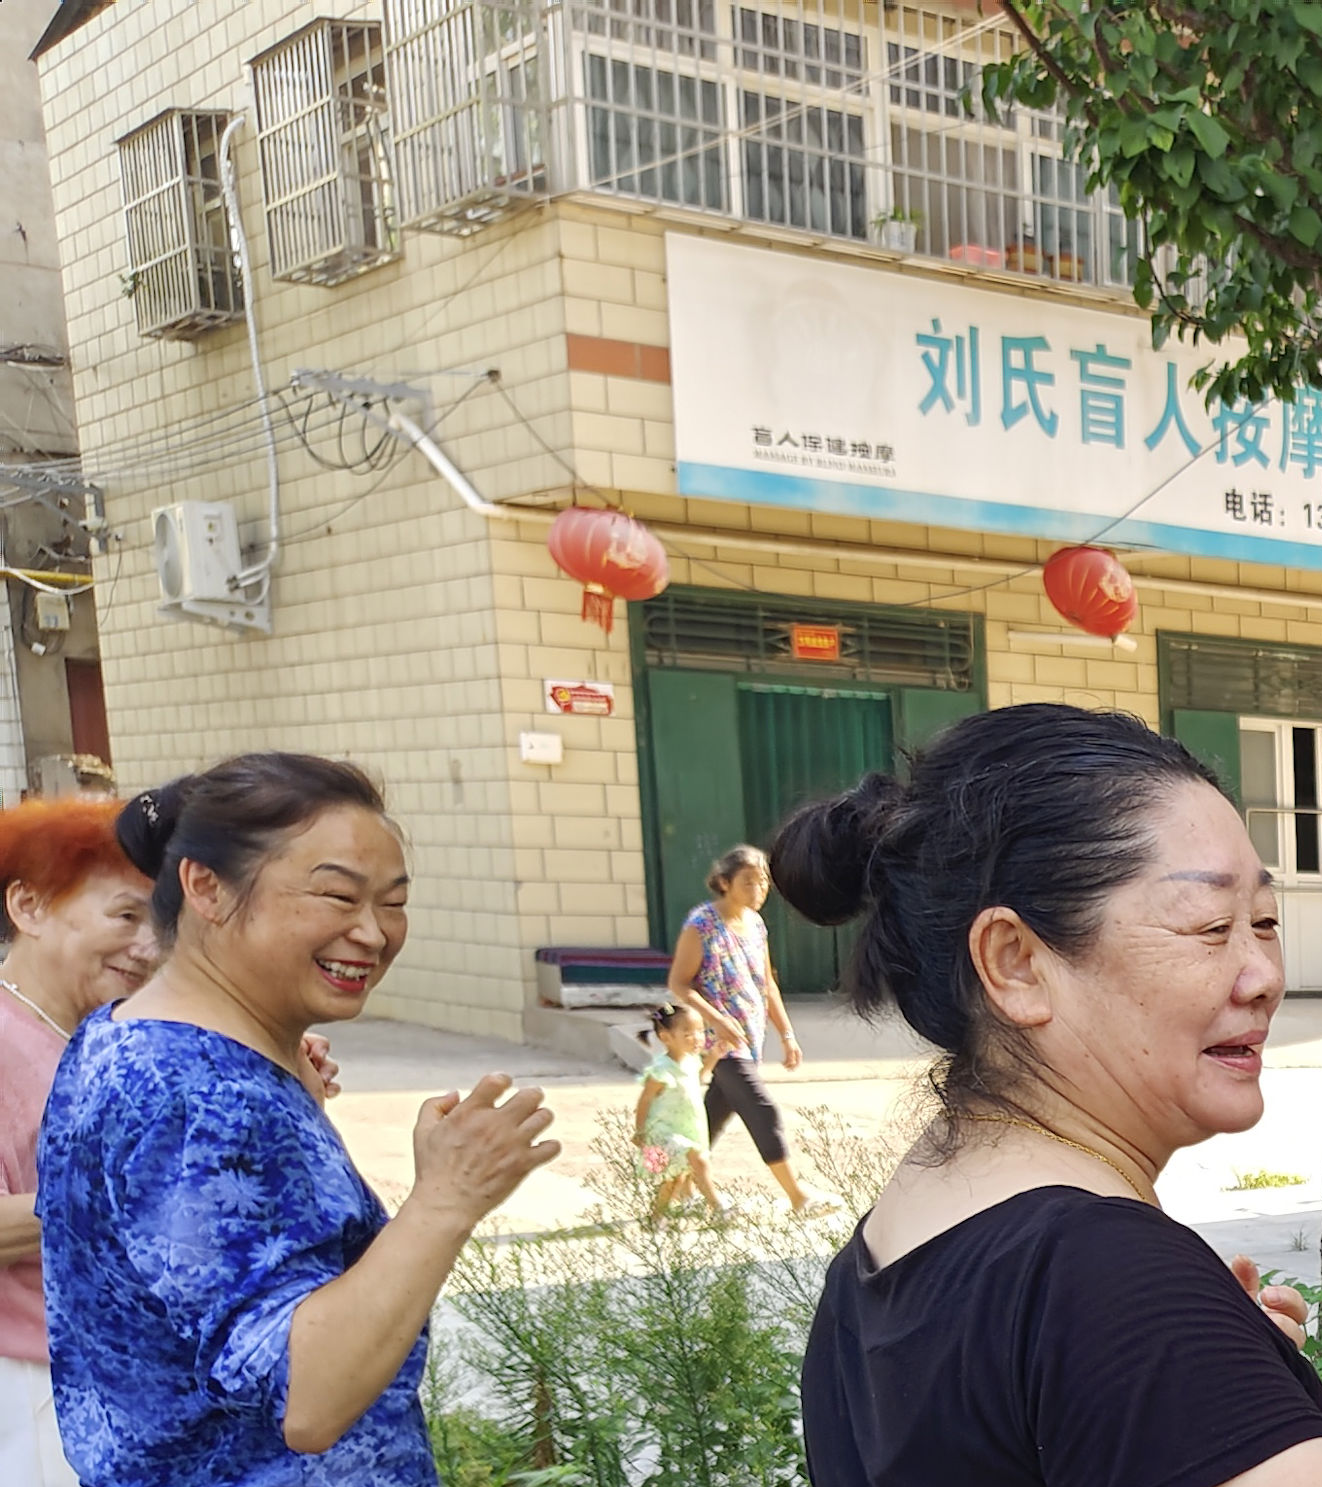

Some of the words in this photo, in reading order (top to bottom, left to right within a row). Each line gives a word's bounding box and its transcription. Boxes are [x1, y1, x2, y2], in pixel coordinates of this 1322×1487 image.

[752, 426, 895, 463] 盲人保健按摩
